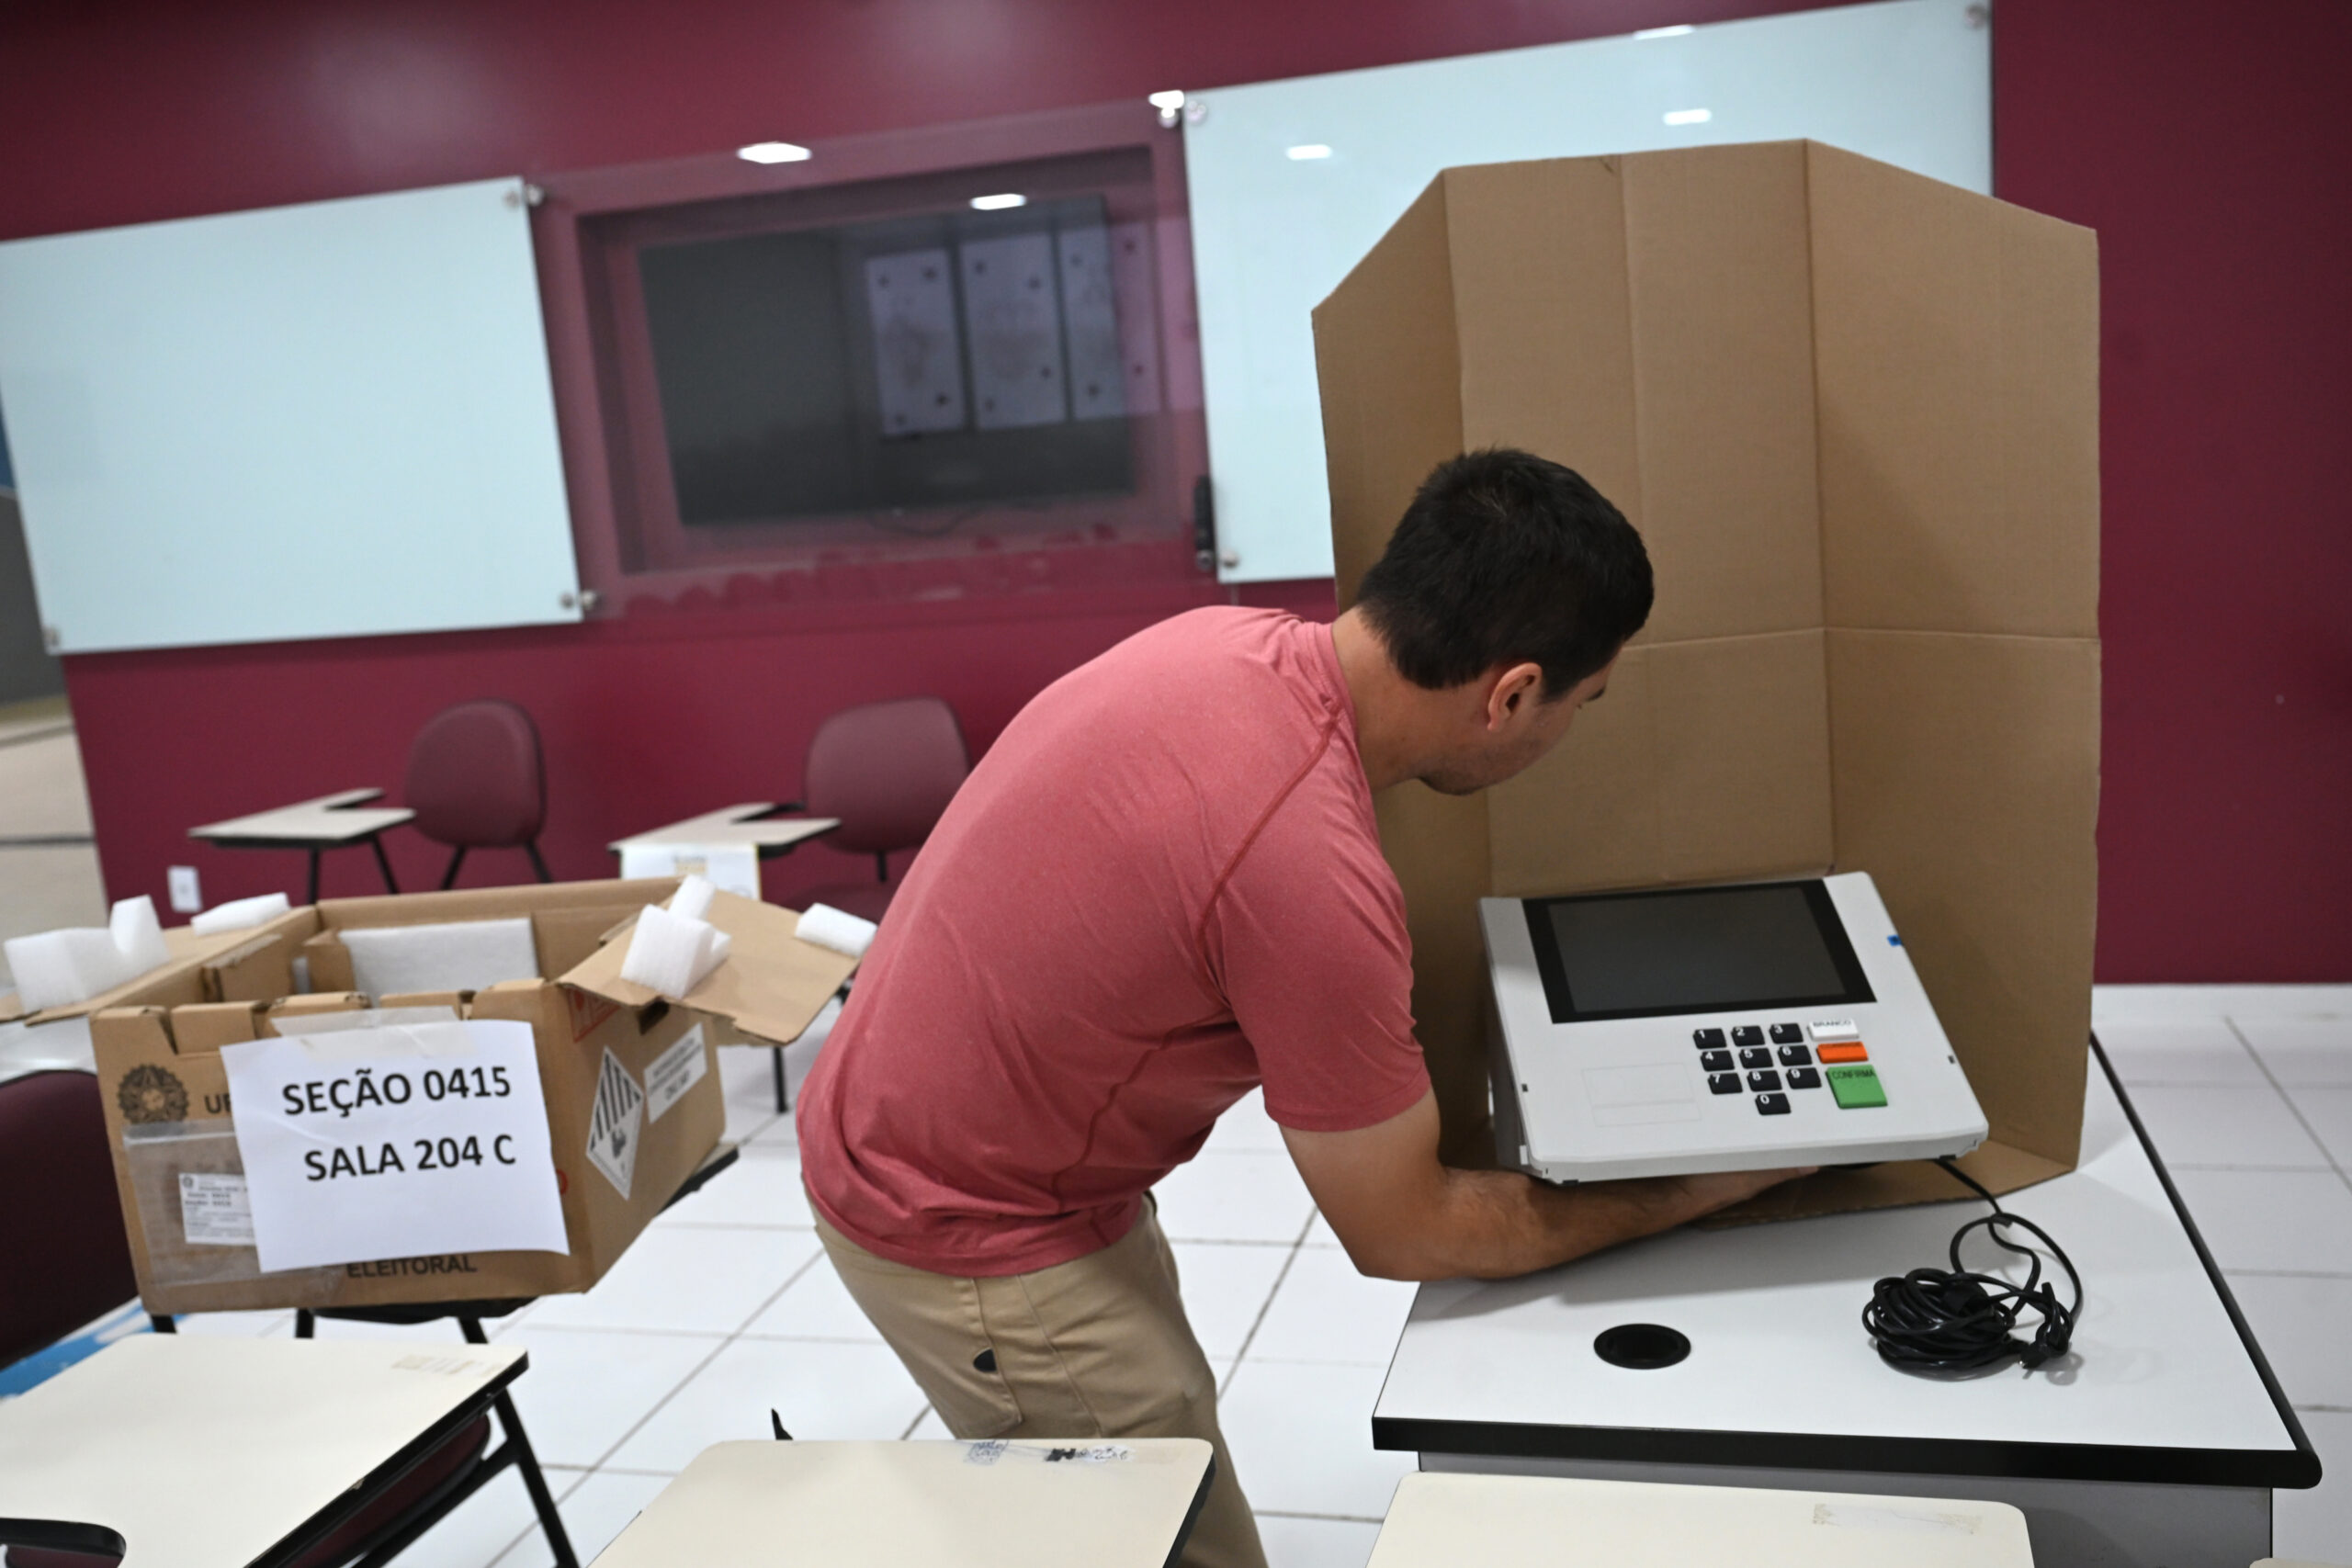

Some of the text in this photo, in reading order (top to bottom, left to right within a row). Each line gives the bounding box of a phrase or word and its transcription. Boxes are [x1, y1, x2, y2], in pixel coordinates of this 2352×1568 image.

[1736, 1027, 1745, 1036] 2
[1774, 1024, 1783, 1033] 3
[1698, 1030, 1705, 1039] 1
[1744, 1049, 1753, 1058] 5
[1782, 1046, 1792, 1055] 6
[1705, 1052, 1713, 1061] 4
[1713, 1073, 1720, 1083] 7
[1752, 1070, 1761, 1080] 8
[1791, 1069, 1800, 1078] 9
[1831, 1068, 1876, 1079] CONFIRMA
[283, 1066, 511, 1118] SEÇÃO 0415
[1759, 1094, 1770, 1104] 0
[304, 1134, 515, 1181] SALA 204 C
[345, 1255, 478, 1278] ELEITORAL
